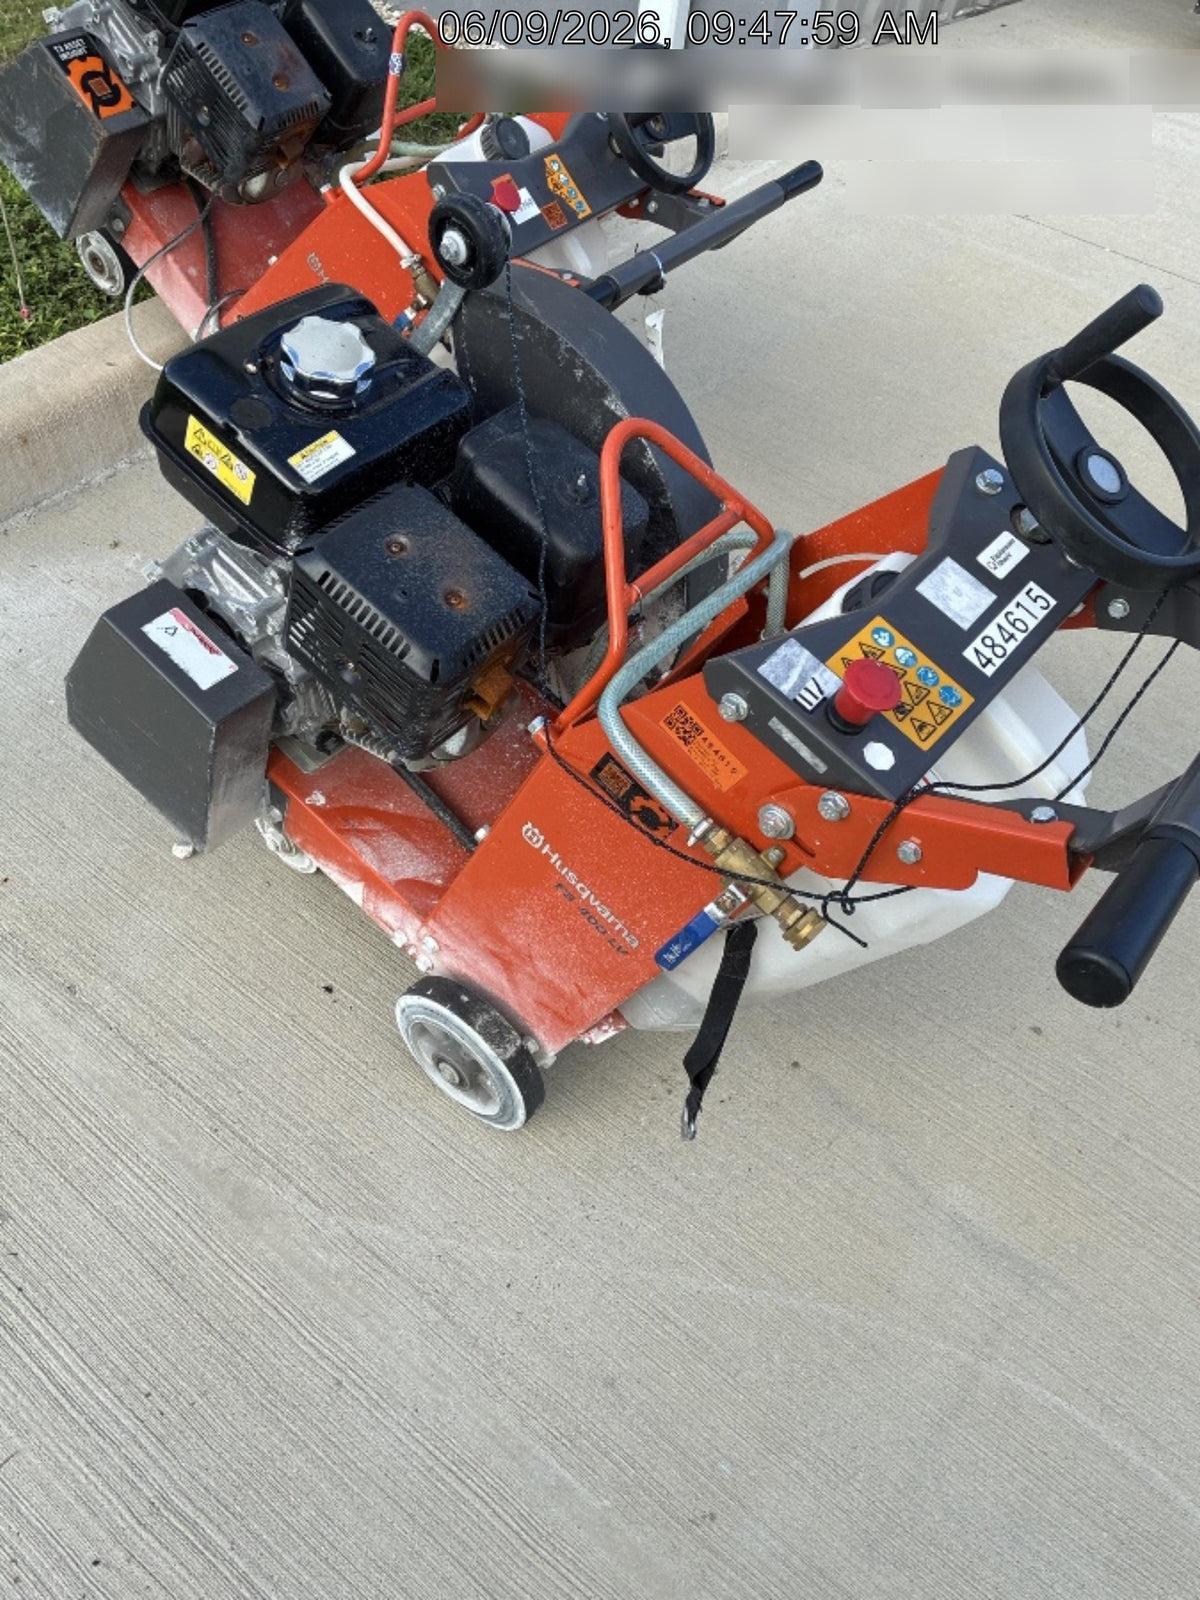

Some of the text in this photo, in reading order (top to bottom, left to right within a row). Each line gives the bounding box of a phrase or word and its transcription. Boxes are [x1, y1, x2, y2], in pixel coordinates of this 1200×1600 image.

[973, 586, 1050, 667] 484615
[540, 843, 640, 949] Husqvarna
[578, 907, 608, 936] 400
